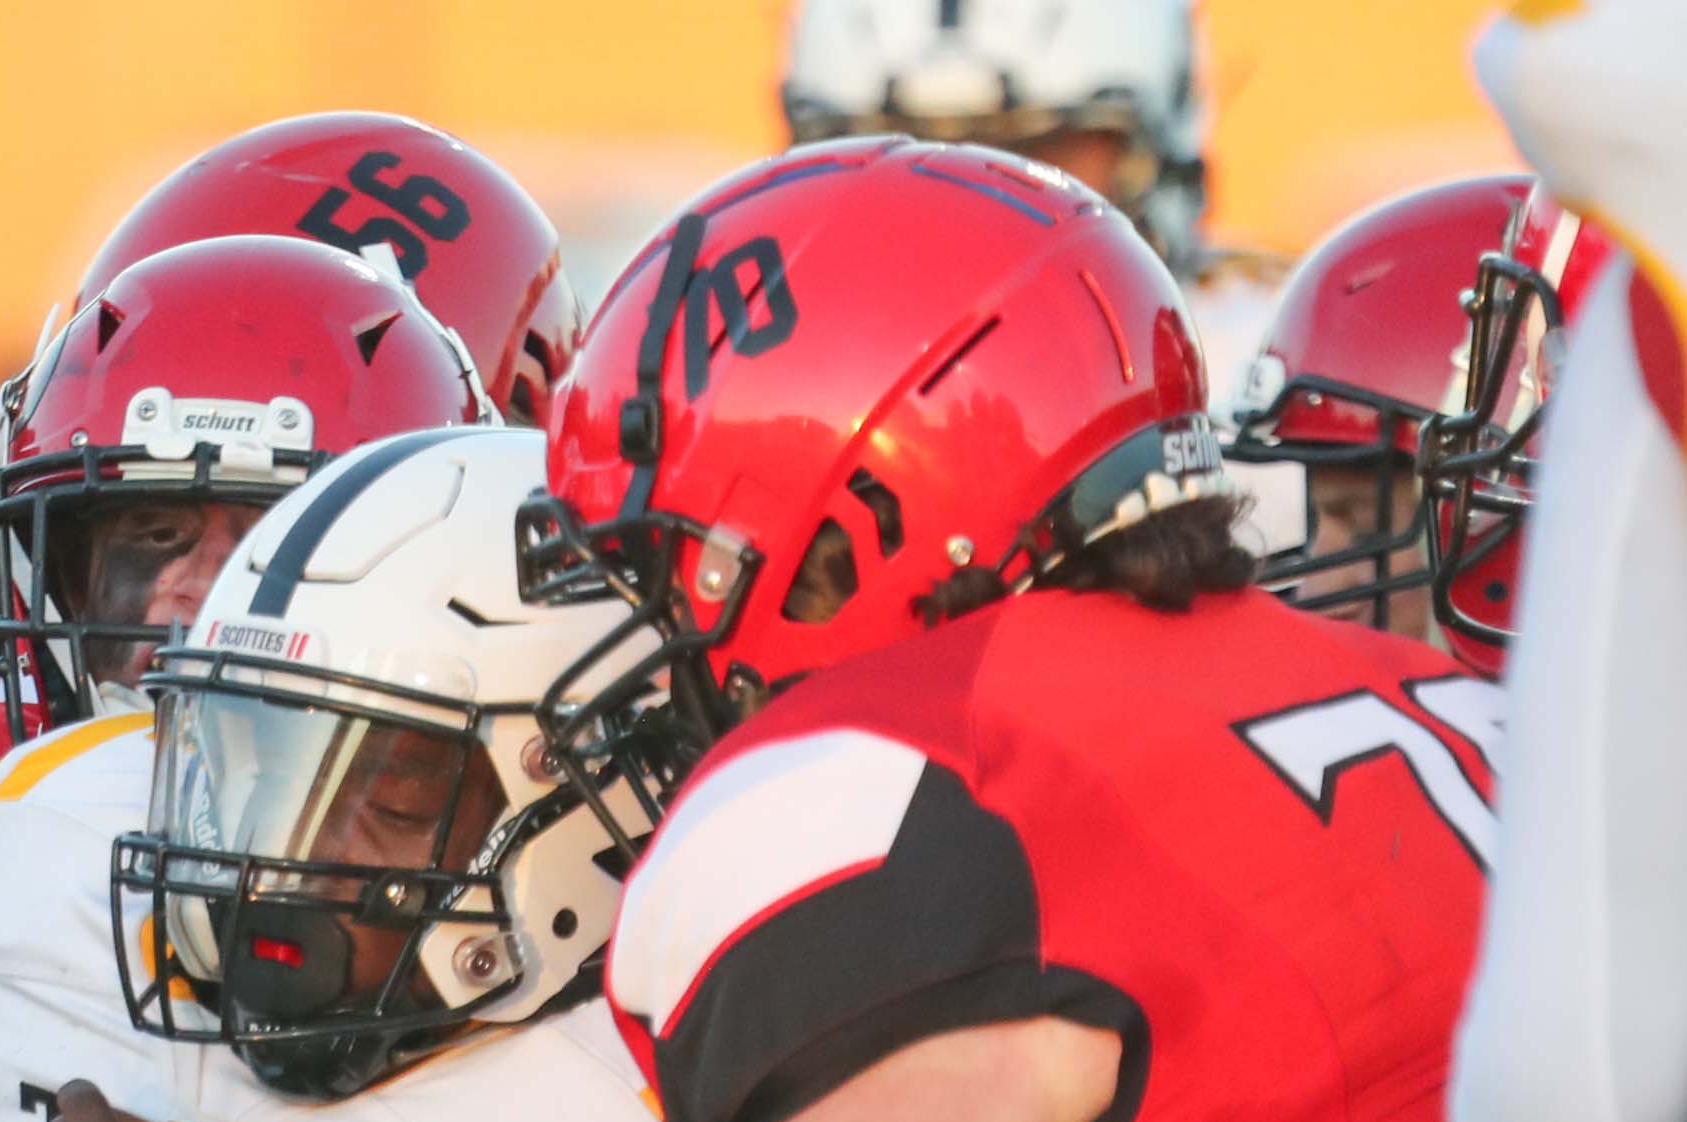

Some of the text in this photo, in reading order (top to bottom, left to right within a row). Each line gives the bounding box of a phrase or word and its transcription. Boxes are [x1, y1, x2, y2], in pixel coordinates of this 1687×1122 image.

[295, 151, 472, 281] 56
[182, 410, 256, 432] schutt
[218, 624, 286, 653] SCOTTIES
